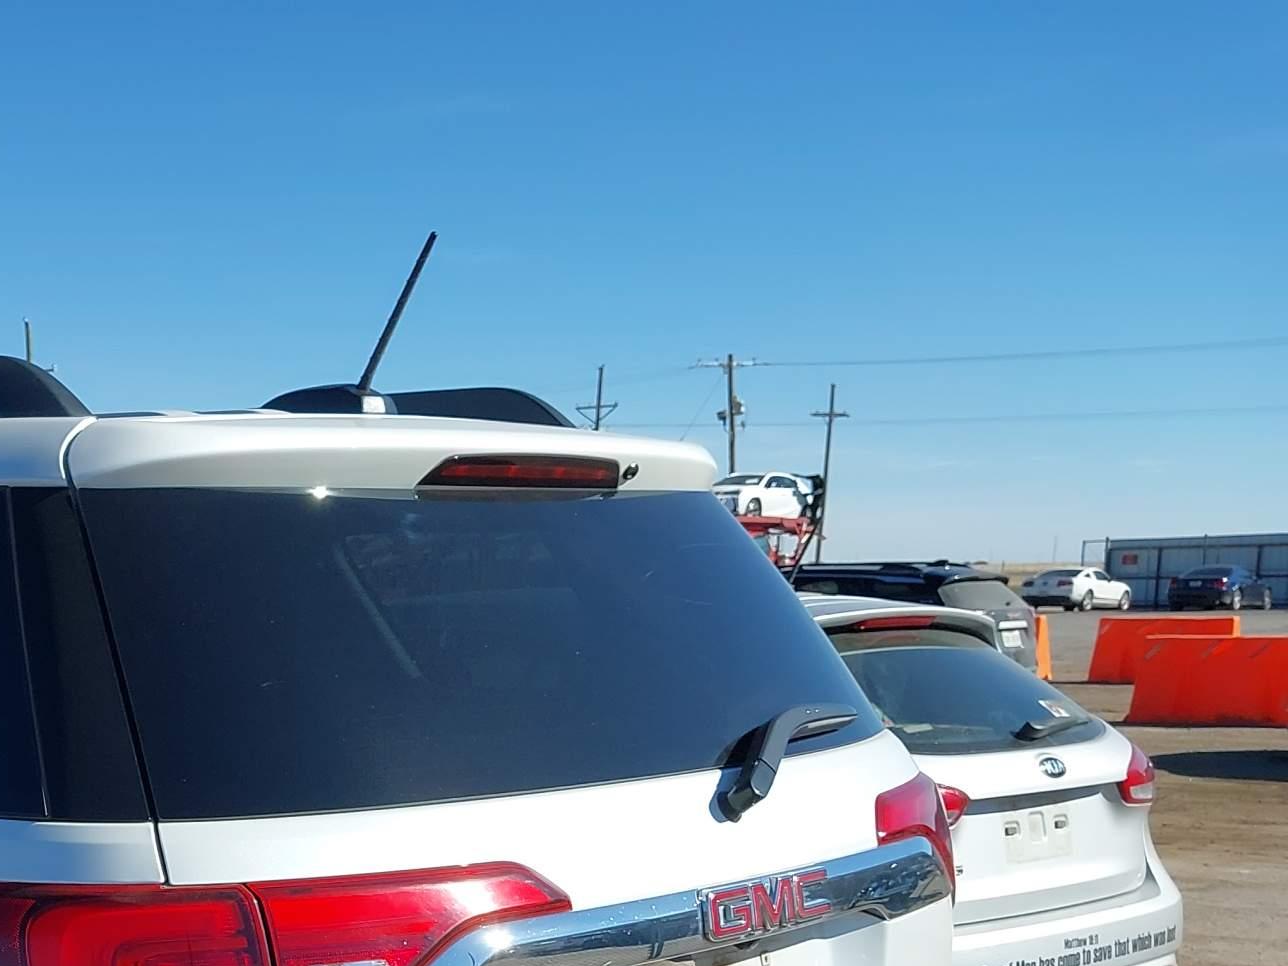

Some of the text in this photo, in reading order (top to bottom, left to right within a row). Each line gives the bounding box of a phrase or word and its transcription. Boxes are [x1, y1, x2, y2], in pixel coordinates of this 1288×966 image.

[704, 867, 832, 941] GMC
[1082, 948, 1092, 965] to
[1093, 944, 1112, 963] save
[1114, 937, 1130, 958] that
[1132, 932, 1152, 953] which
[1154, 929, 1166, 947] was
